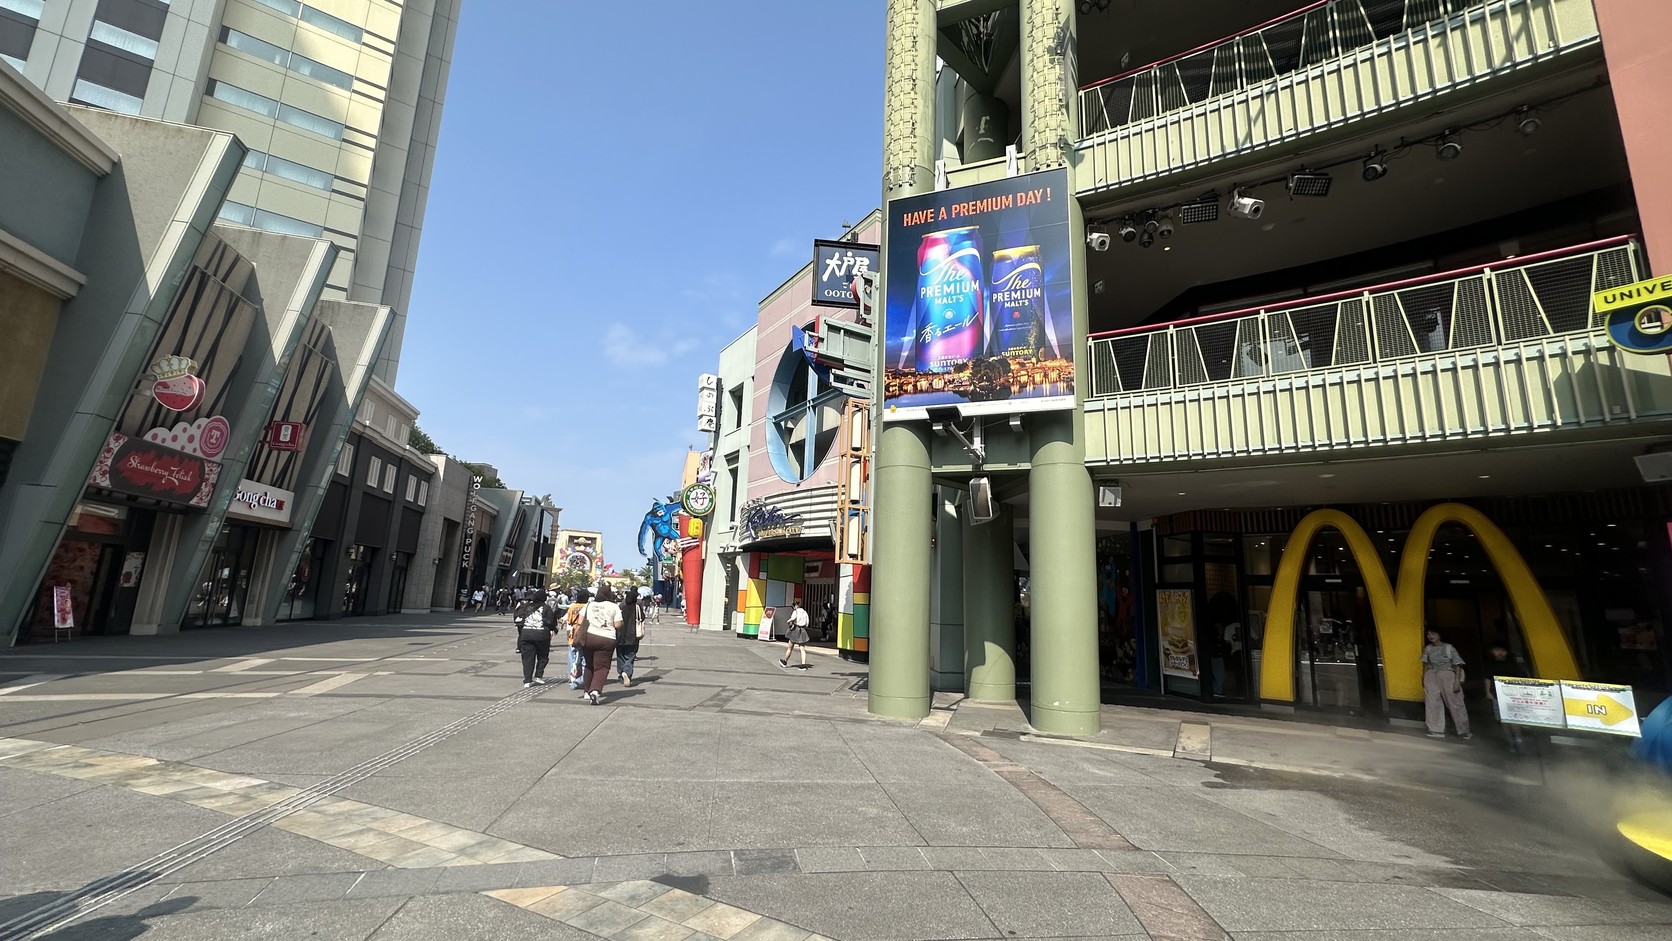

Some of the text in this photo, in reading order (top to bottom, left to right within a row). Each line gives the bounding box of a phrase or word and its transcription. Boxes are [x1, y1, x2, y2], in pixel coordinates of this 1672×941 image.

[903, 187, 1051, 227] HAVE A PREMIUM DAY !
[822, 251, 870, 282] 大戸屋
[933, 261, 966, 284] The
[920, 280, 979, 299] PREMIUM
[1001, 272, 1032, 291] The
[824, 289, 853, 299] OOTO
[934, 294, 964, 305] MALT'S
[992, 288, 1041, 303] PREMIUM
[1603, 280, 1672, 304] UNIVE
[1004, 299, 1029, 308] MALT'S
[920, 311, 979, 343] 香るエール
[703, 376, 715, 429] しのぶ庵
[127, 454, 171, 484] Strawberry
[260, 491, 277, 509] cha
[690, 490, 708, 506] 好
[462, 475, 483, 568] WOLFGANG PUCK
[1586, 703, 1607, 716] IN
